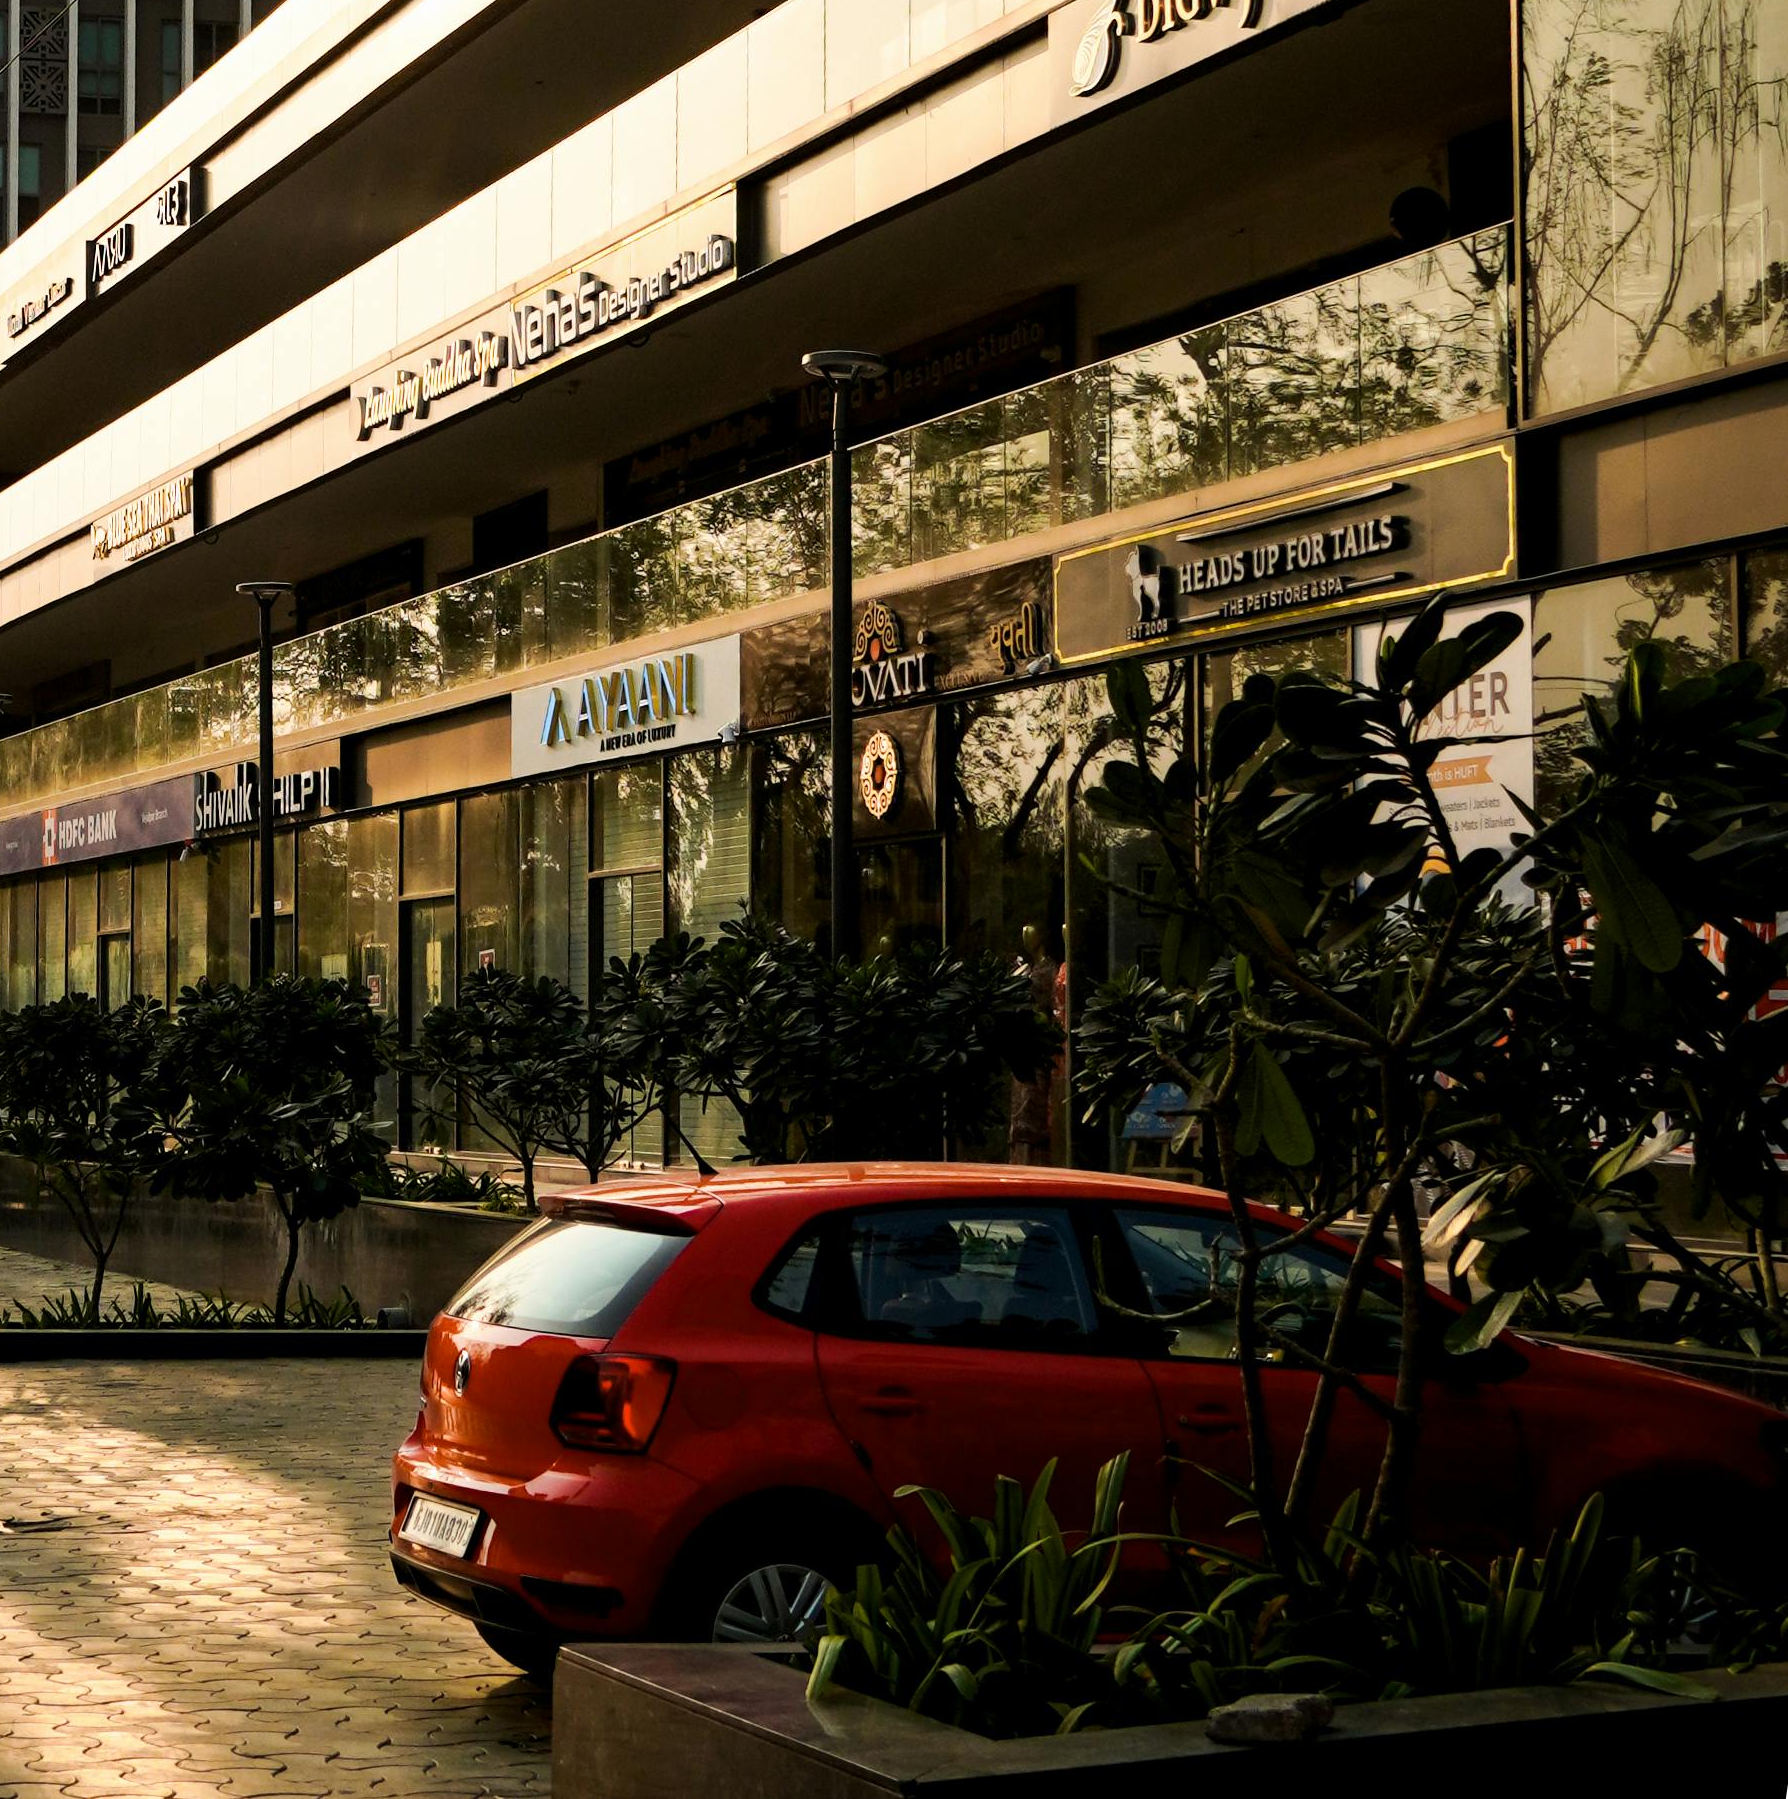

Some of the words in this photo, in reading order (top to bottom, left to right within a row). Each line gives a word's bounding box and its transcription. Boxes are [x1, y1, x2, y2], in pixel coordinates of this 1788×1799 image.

[599, 267, 670, 320] Designer
[422, 340, 473, 401] Buddha
[474, 331, 506, 387] Spa
[1179, 552, 1245, 594] HEADS
[1253, 544, 1281, 577] UP
[1287, 532, 1327, 569] FOR
[1329, 515, 1394, 560] TAILS
[1223, 599, 1244, 618] THE
[1246, 593, 1270, 614] PET
[1270, 585, 1310, 610] STORE
[1319, 577, 1343, 597] SPA
[852, 652, 927, 707] UVATI
[600, 739, 605, 752] A
[606, 735, 621, 751] NEW
[622, 732, 636, 748] ERA
[636, 729, 647, 744] OF
[648, 724, 676, 743] LUXURY
[258, 770, 315, 817] HILP
[58, 816, 86, 850] HDFC
[87, 809, 117, 845] BANK
